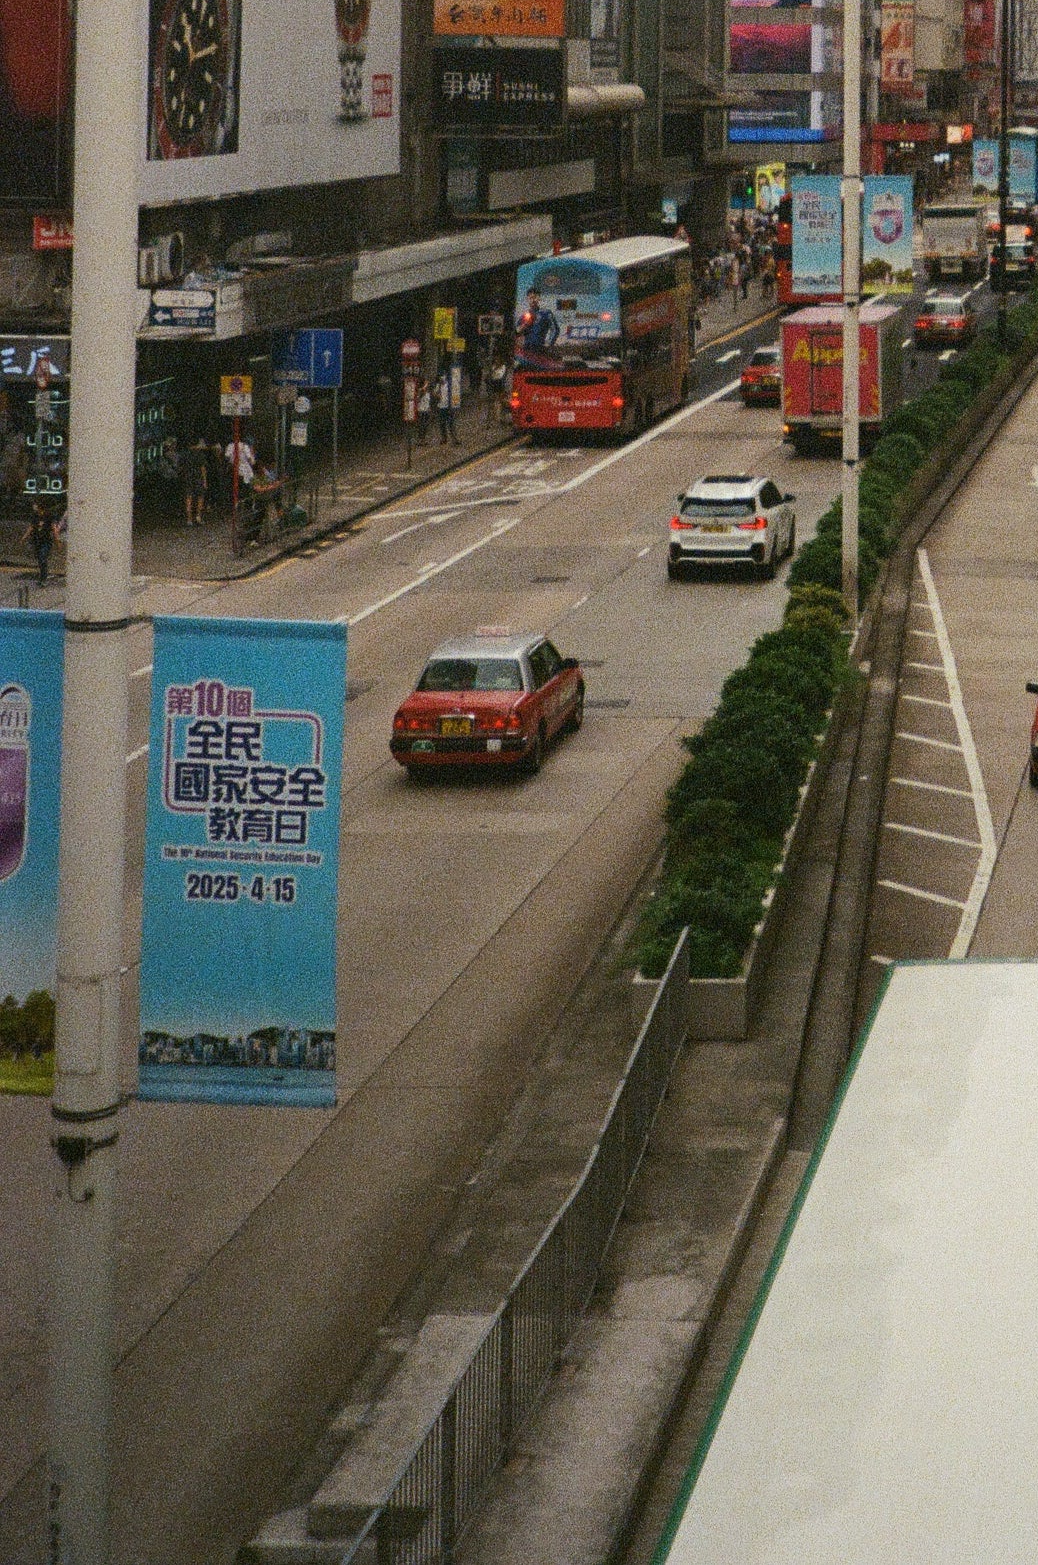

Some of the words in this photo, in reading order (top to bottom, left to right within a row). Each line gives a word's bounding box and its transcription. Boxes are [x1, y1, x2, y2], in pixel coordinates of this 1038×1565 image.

[503, 92, 555, 101] EXPRESS
[166, 682, 252, 718] 第10個
[187, 721, 262, 763] 全民
[174, 762, 325, 809] 國家安全
[208, 808, 307, 845] 教育日
[230, 851, 262, 863] Security
[265, 852, 305, 863] Education
[307, 853, 321, 865] Day
